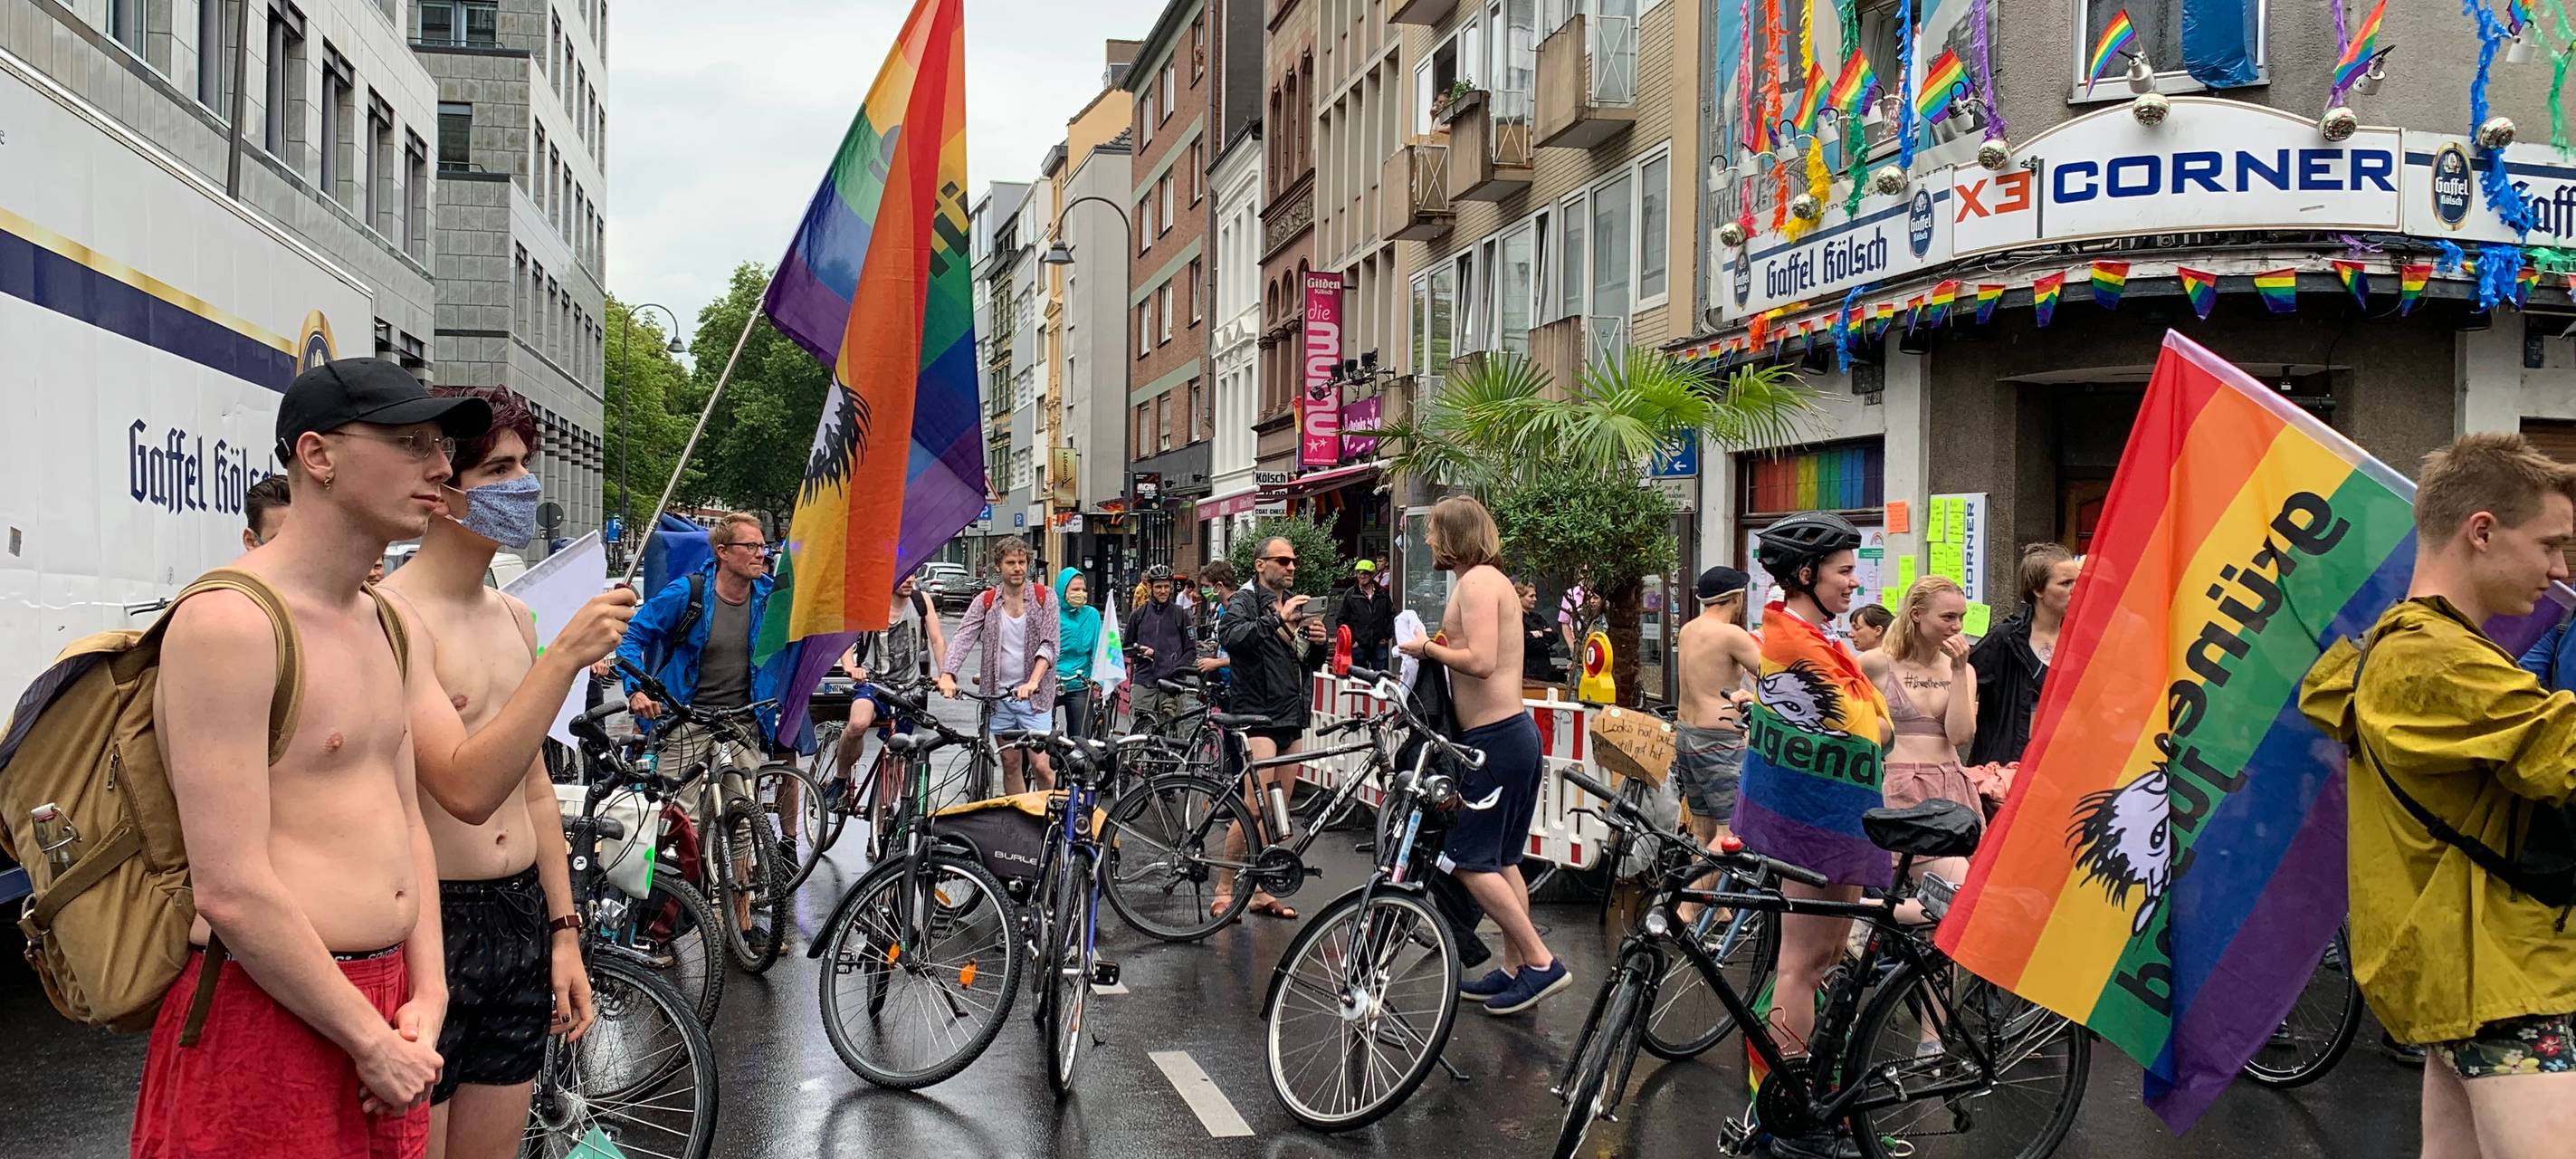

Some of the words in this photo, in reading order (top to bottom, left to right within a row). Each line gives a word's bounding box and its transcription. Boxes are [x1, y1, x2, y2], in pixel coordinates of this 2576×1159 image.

[2053, 148, 2398, 204] CORNER
[2435, 177, 2469, 196] Gaffel
[1910, 214, 1932, 233] Gaffel
[1766, 247, 1817, 300] Gaffel
[1823, 225, 1887, 285] Kölsch
[1307, 277, 1340, 290] Gilden
[1308, 300, 1331, 321] die
[129, 417, 208, 515] Gaffel
[215, 438, 273, 515] Köl
[1255, 472, 1286, 484] Kölsch
[1964, 501, 1975, 600] CORNER
[1309, 759, 1370, 837] corratec
